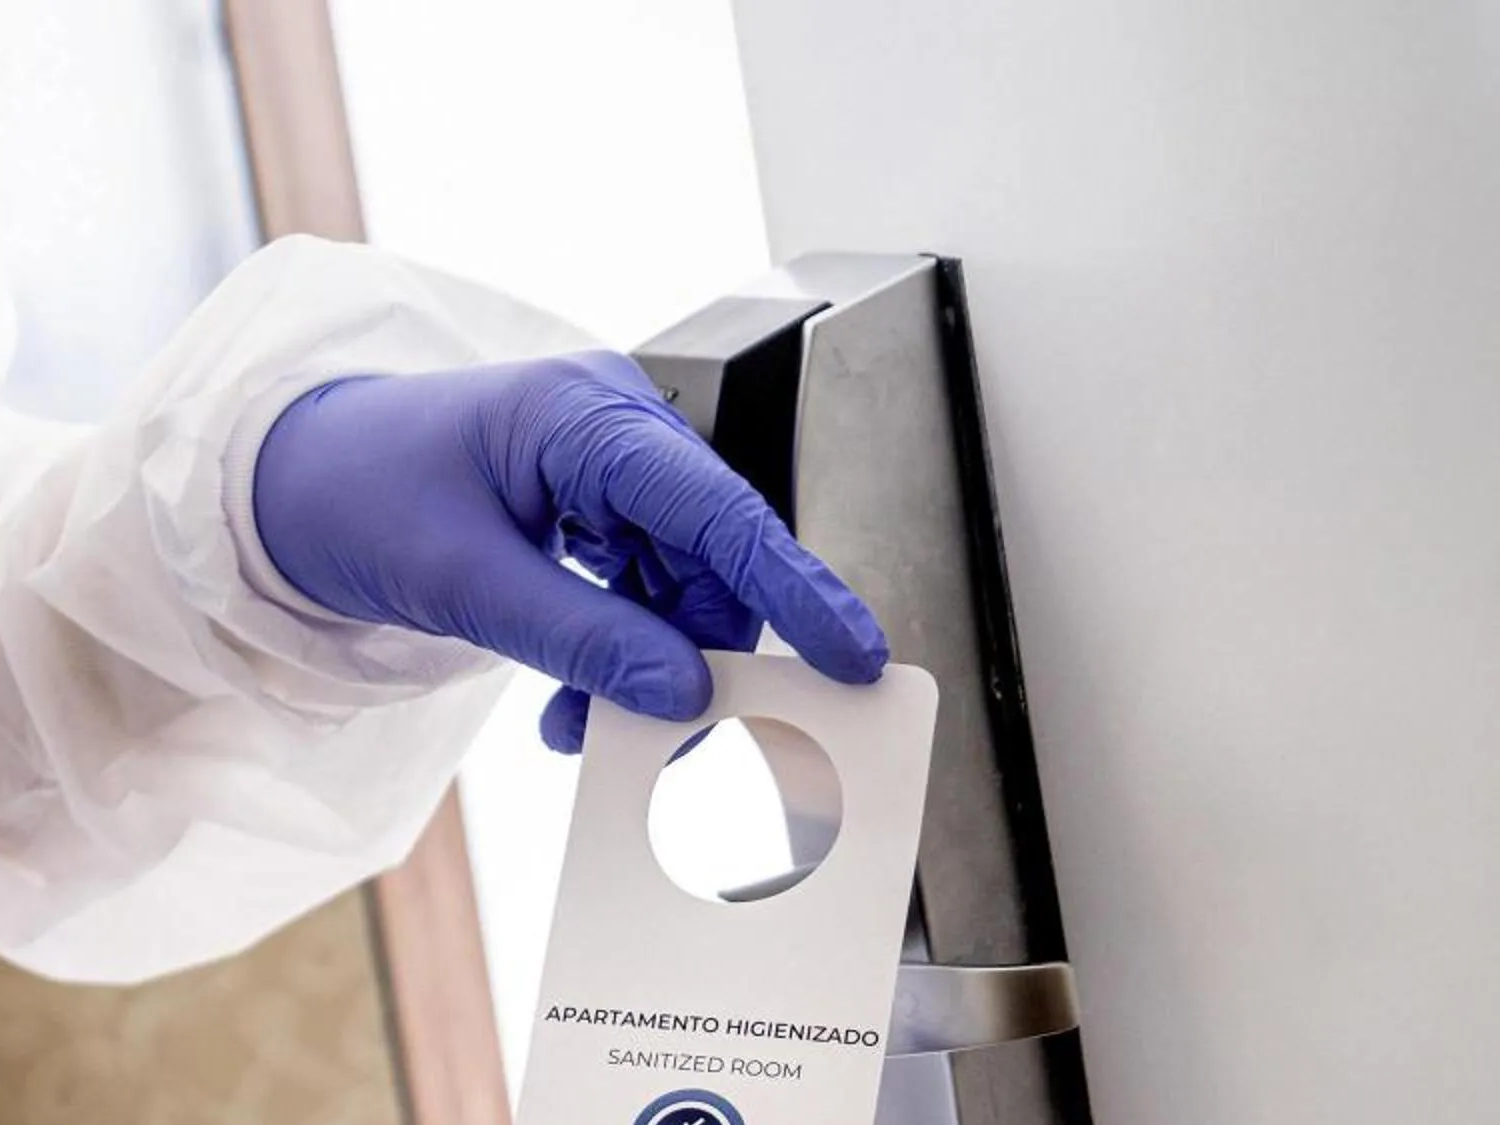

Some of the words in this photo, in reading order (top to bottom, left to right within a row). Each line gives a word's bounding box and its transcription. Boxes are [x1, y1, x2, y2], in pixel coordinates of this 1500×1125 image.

[545, 1006, 719, 1033] APARTAMENTO
[726, 1019, 880, 1047] HIGIENIZADO
[607, 1049, 725, 1074] SANITIZED
[730, 1058, 803, 1080] ROOM
